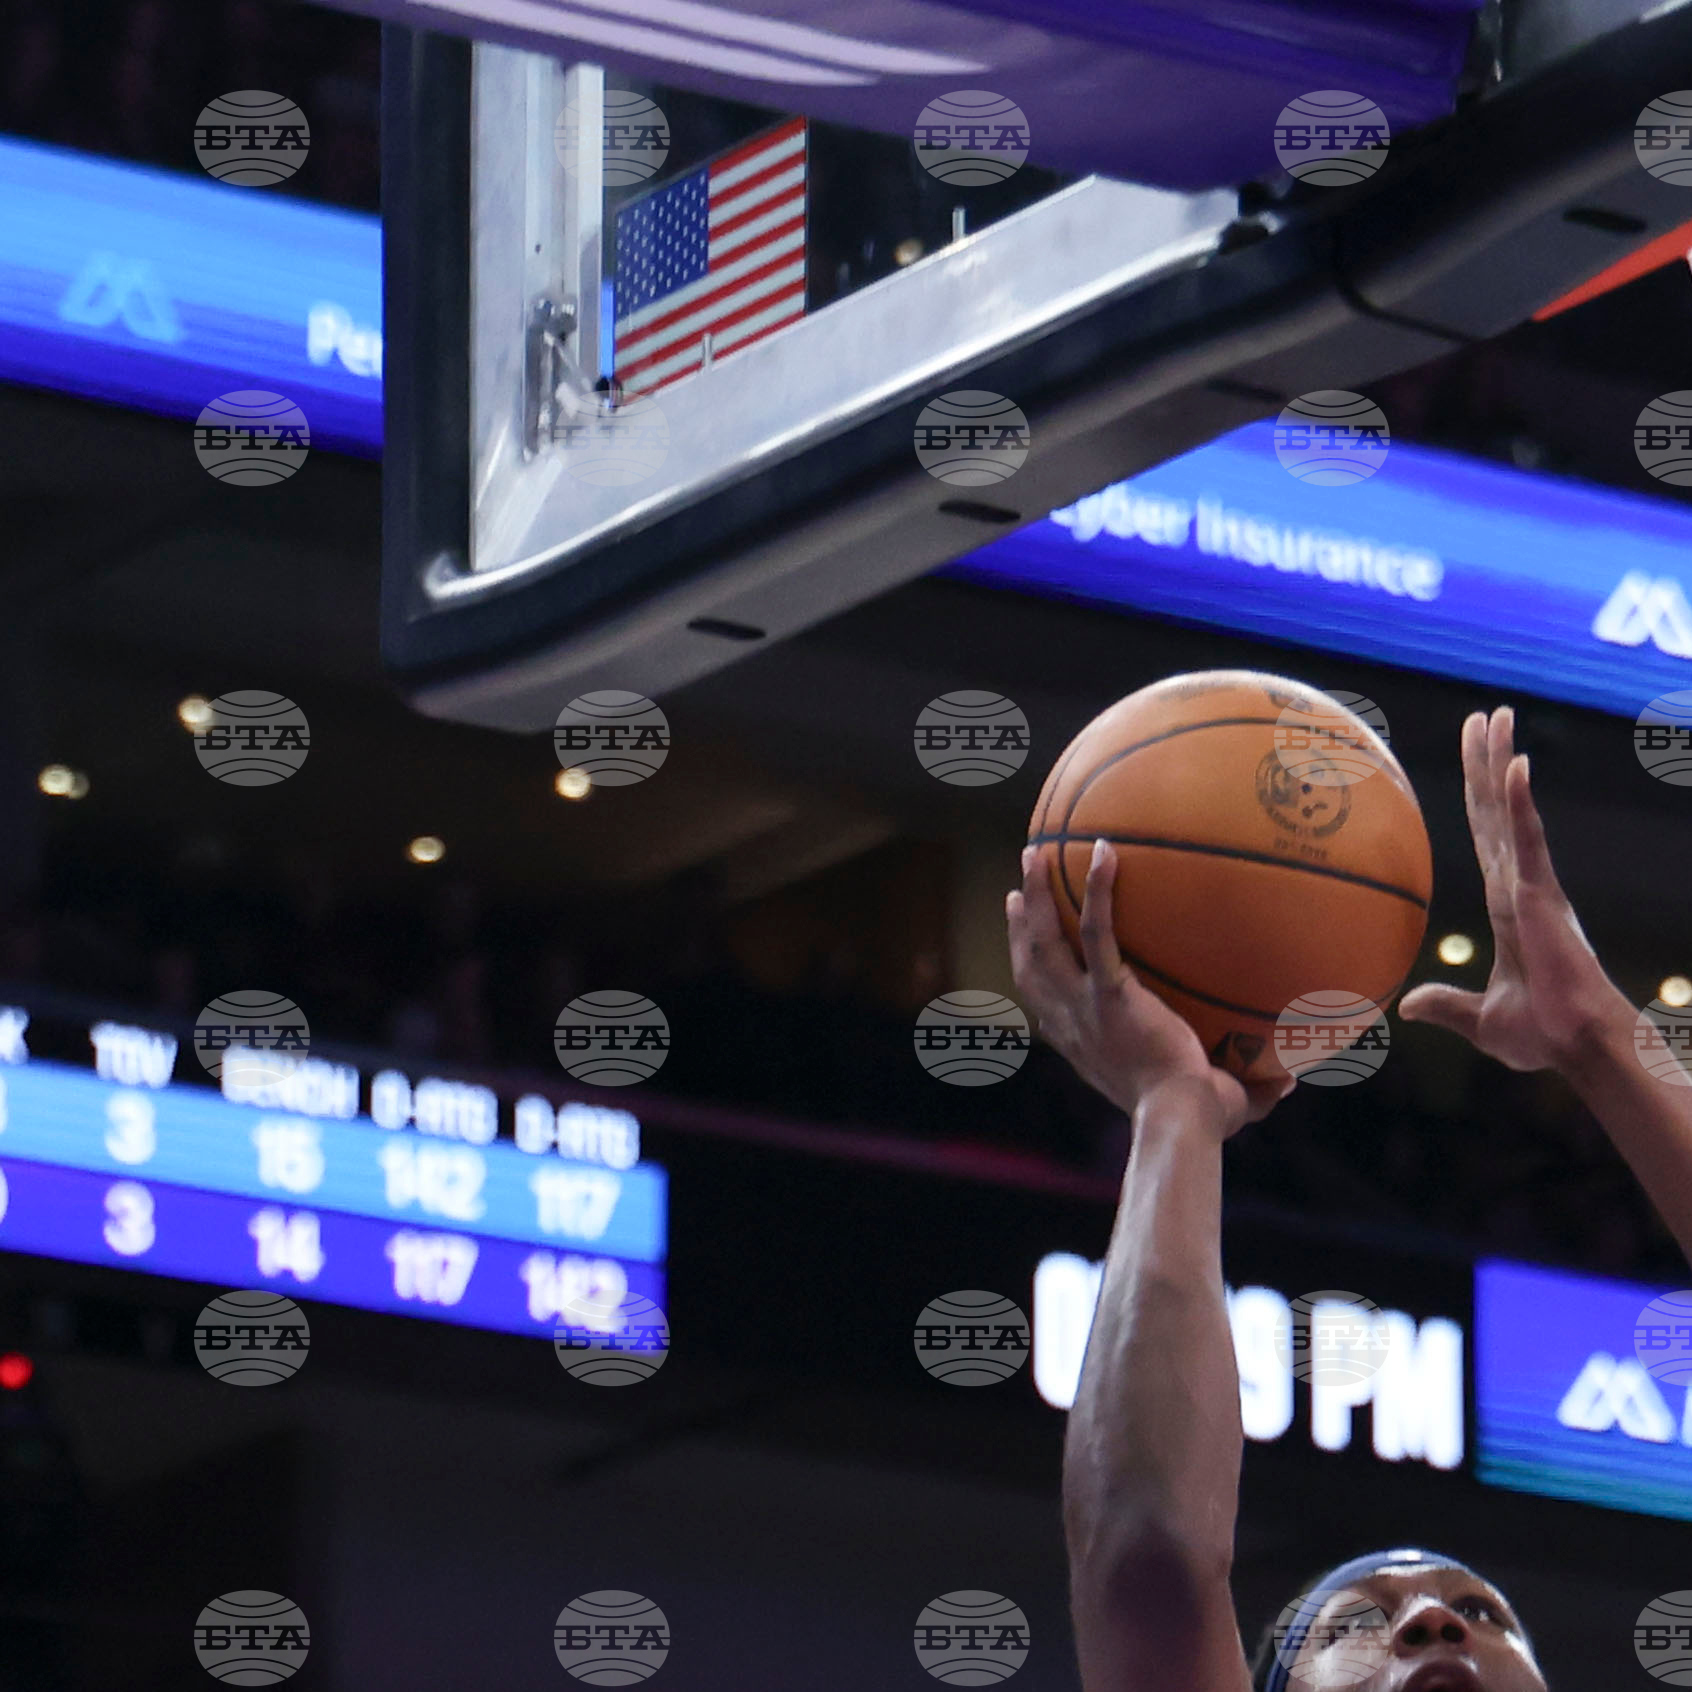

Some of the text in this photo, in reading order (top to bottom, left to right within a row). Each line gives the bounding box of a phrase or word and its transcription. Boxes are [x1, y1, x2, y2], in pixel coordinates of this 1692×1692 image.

[1197, 494, 1444, 602] Insurance
[104, 1088, 157, 1166] 3
[102, 1179, 157, 1258] 3
